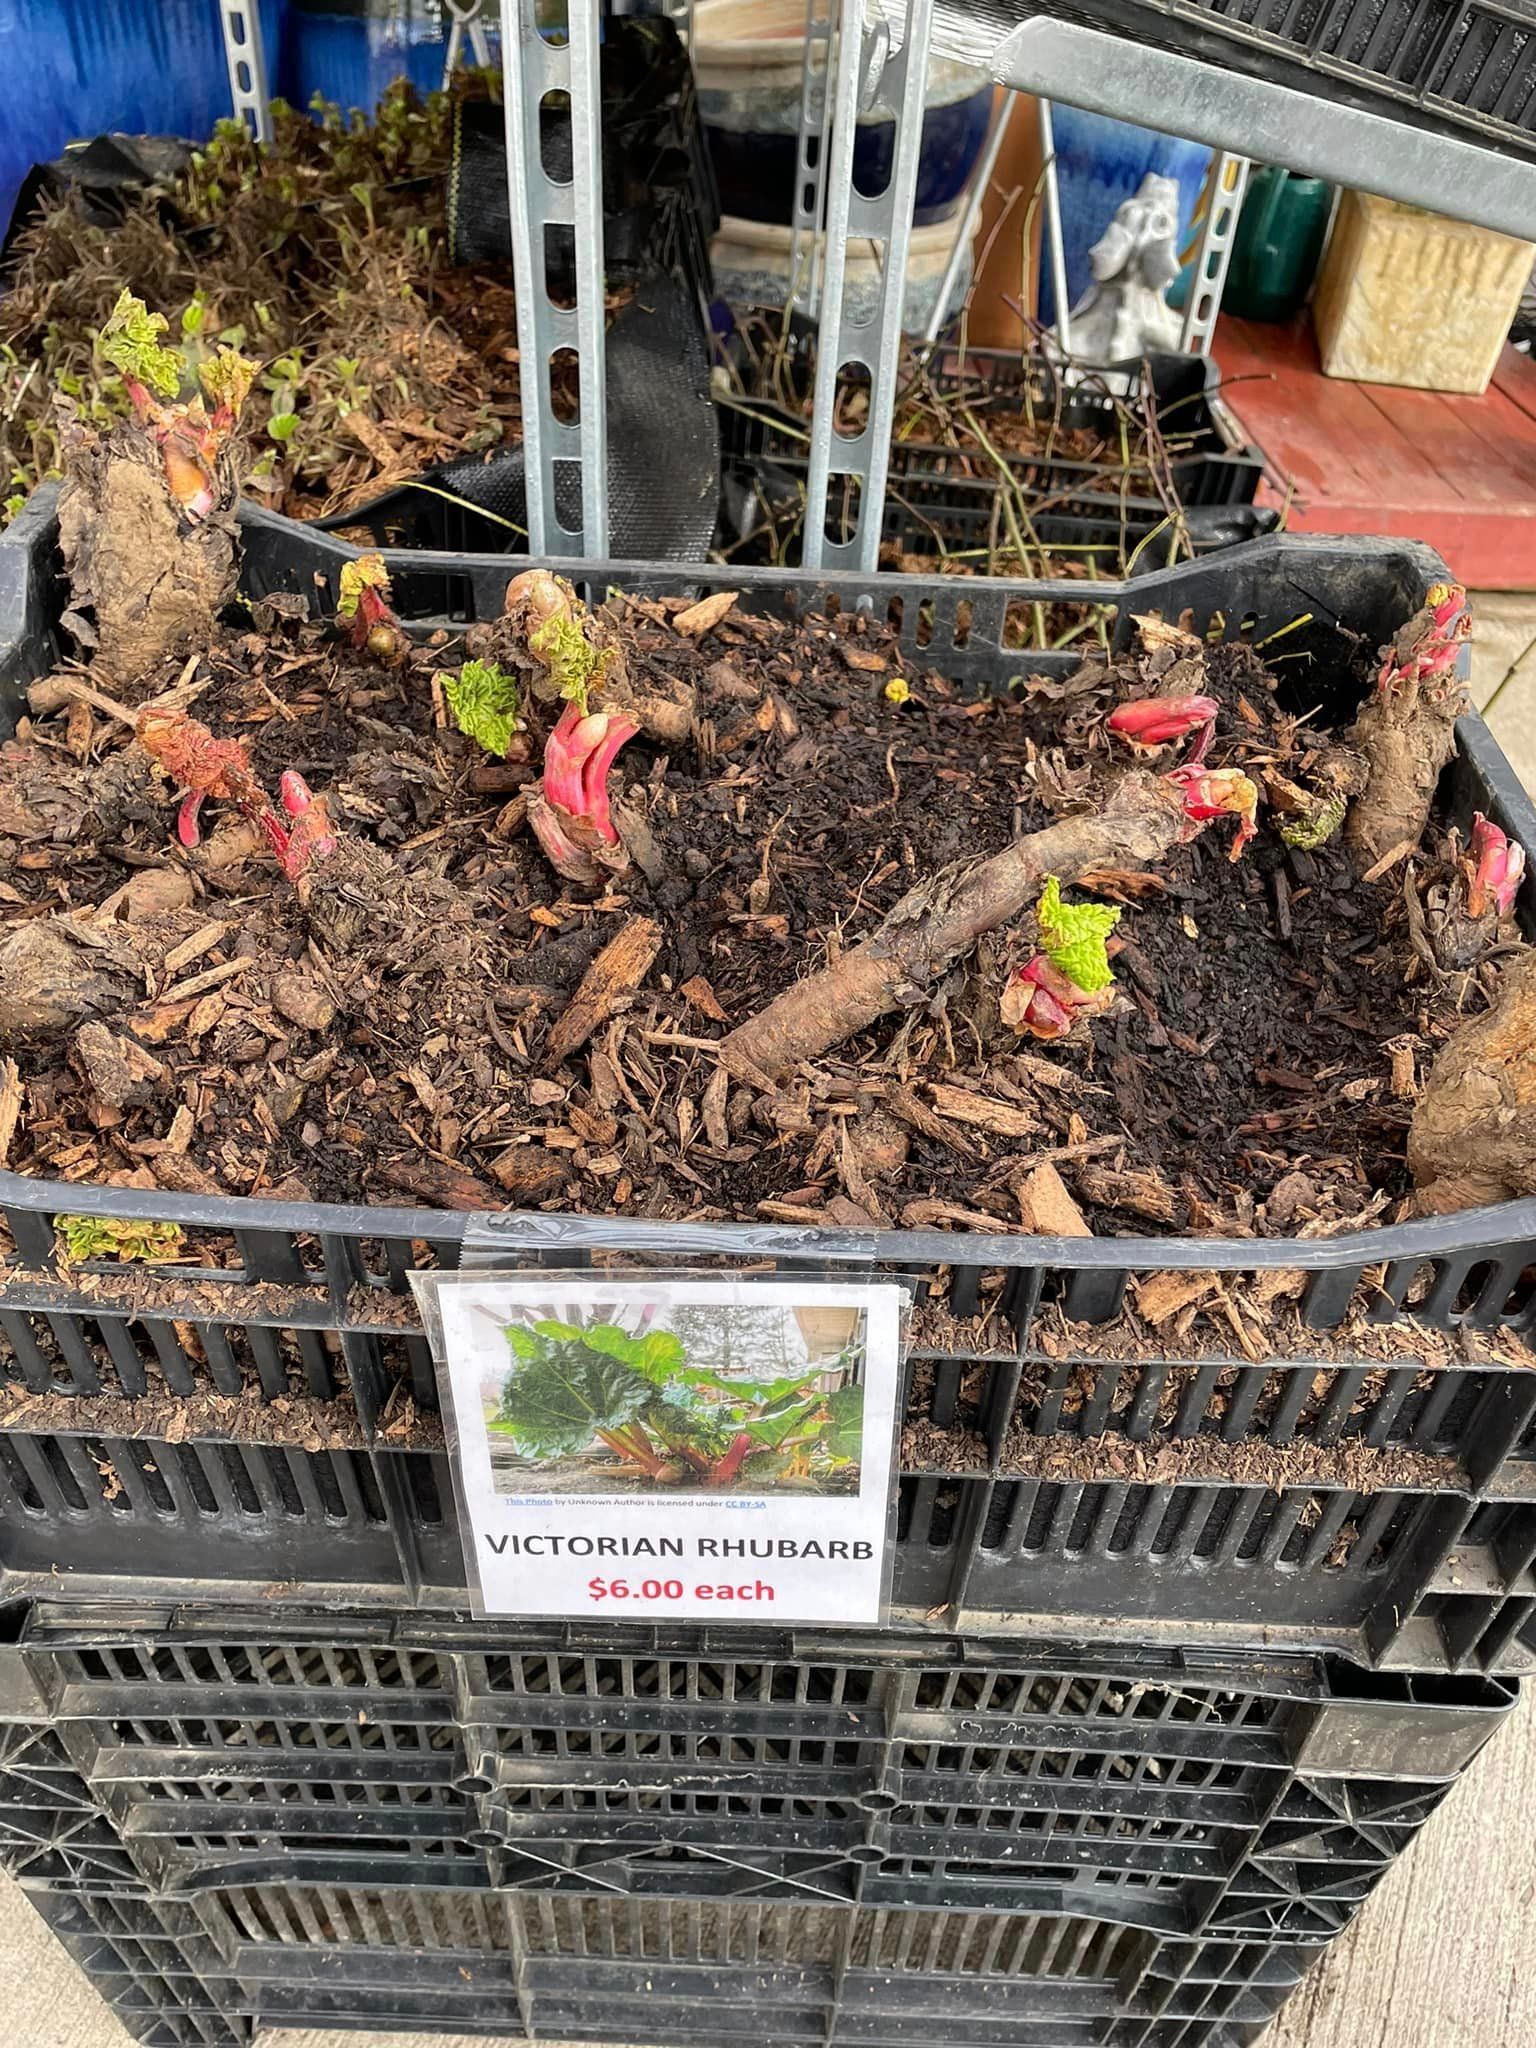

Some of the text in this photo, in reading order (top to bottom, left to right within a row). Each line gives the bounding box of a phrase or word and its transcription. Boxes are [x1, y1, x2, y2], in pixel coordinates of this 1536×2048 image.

[739, 1501, 766, 1509] BY-SA
[485, 1534, 874, 1560] VICTORIAN RHUBARB
[588, 1577, 775, 1601] $6.00 each
